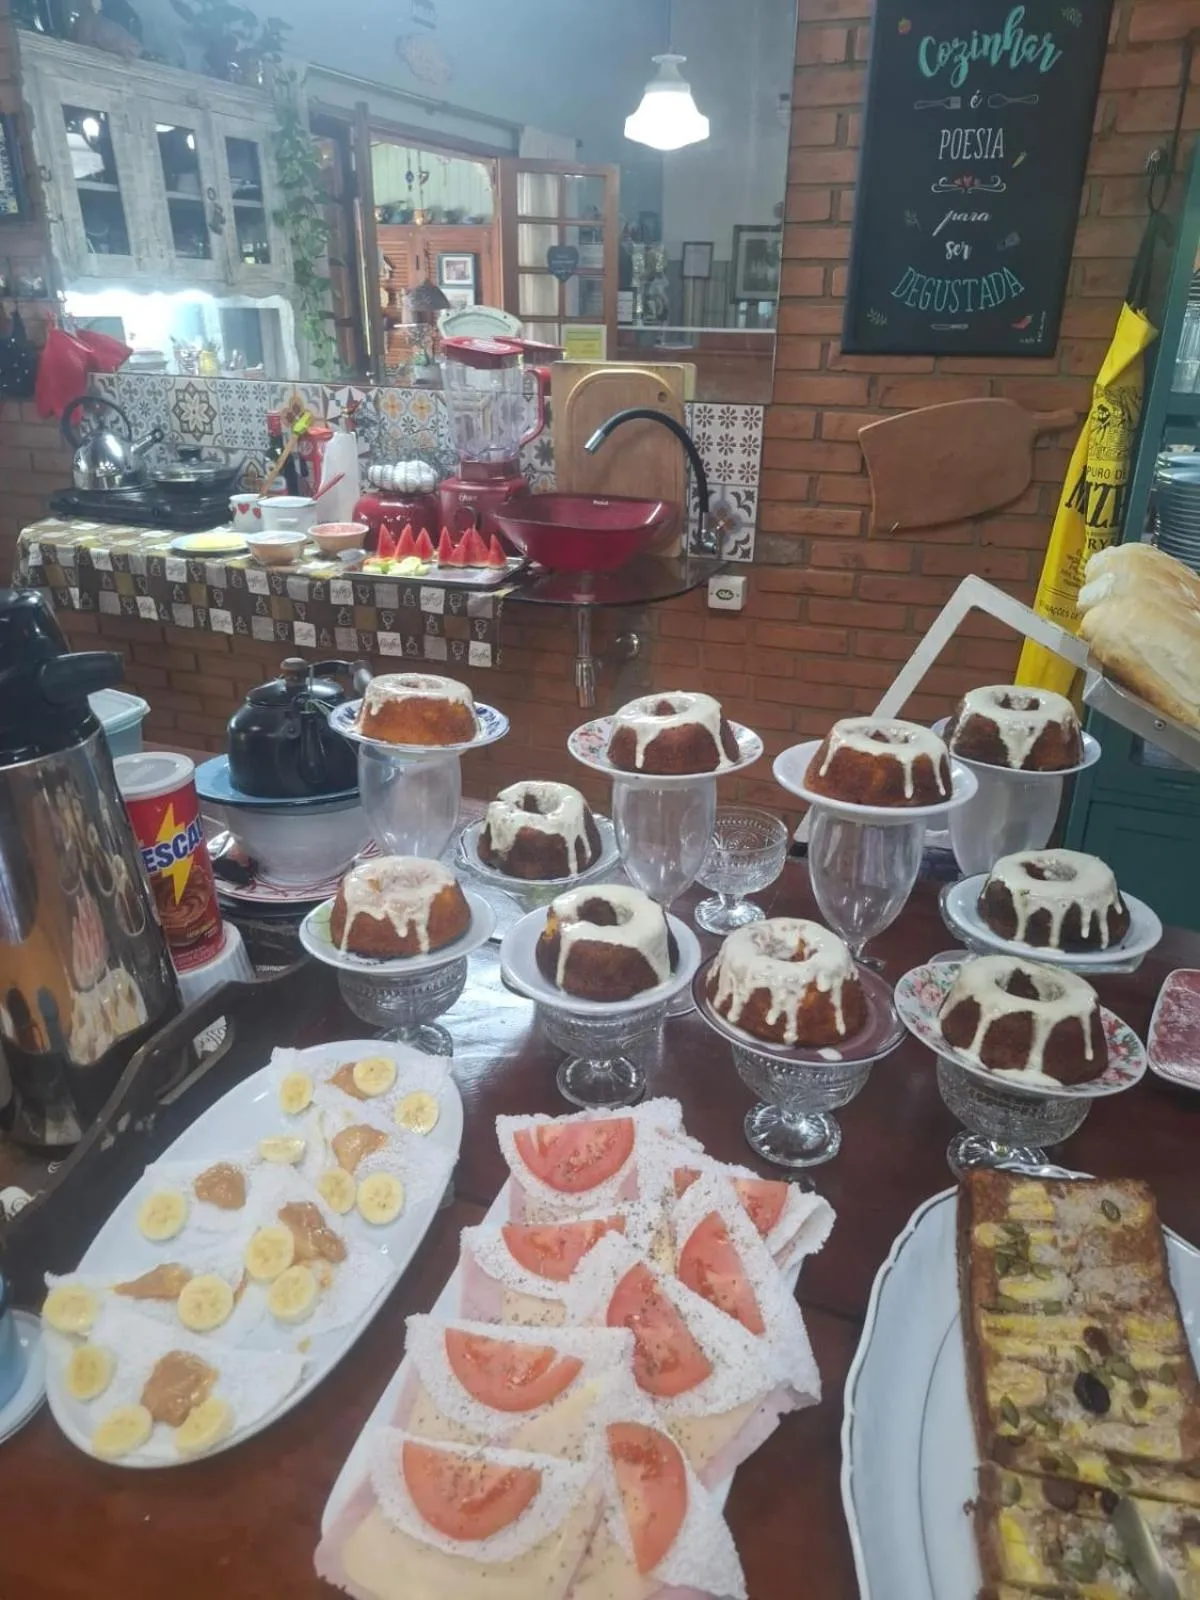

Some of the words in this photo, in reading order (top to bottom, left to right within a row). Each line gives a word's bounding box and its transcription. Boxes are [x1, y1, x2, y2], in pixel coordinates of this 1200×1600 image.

[918, 5, 1063, 89] Cozinhar
[970, 89, 984, 109] é
[938, 127, 1004, 160] POESIA
[931, 209, 992, 237] para
[945, 240, 971, 260] ser
[890, 266, 1025, 313] DEGUSTADA
